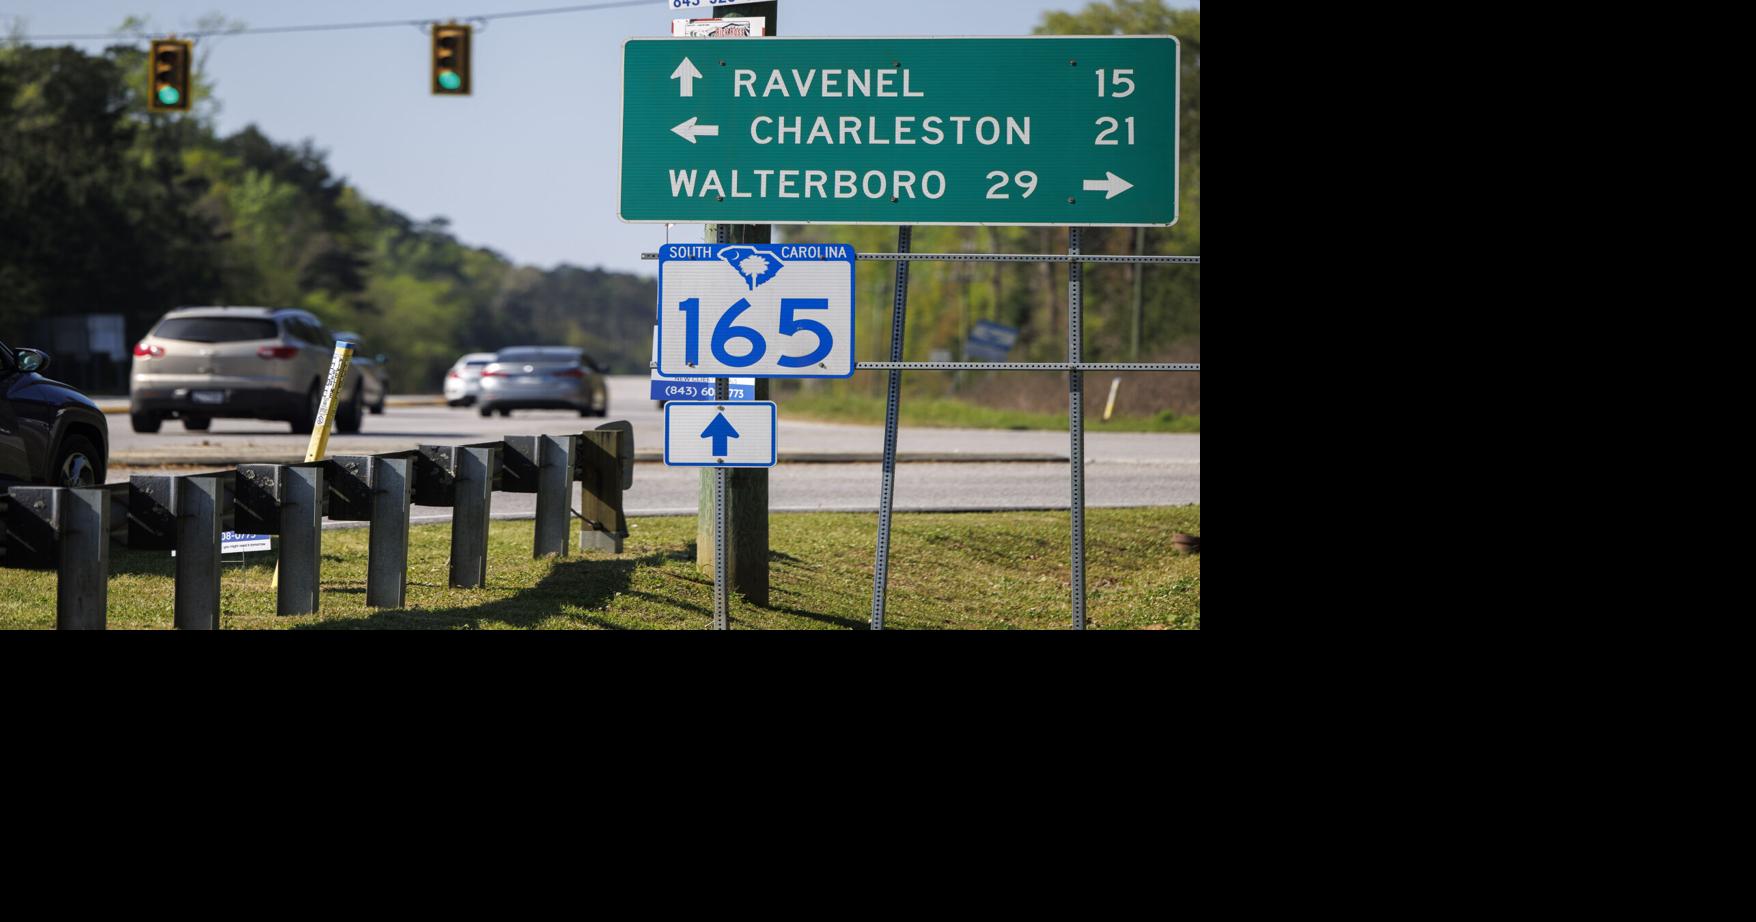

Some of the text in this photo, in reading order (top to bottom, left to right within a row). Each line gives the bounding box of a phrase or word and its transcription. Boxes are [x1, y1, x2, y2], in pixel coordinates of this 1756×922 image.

[733, 68, 1136, 98] RAVENEL 15
[750, 115, 1136, 146] CHARLESTON 21
[668, 169, 1039, 200] WALTERBORO 29
[669, 246, 847, 258] SOUTH CAROLINA
[679, 297, 833, 368] 165
[665, 386, 698, 397] (843)
